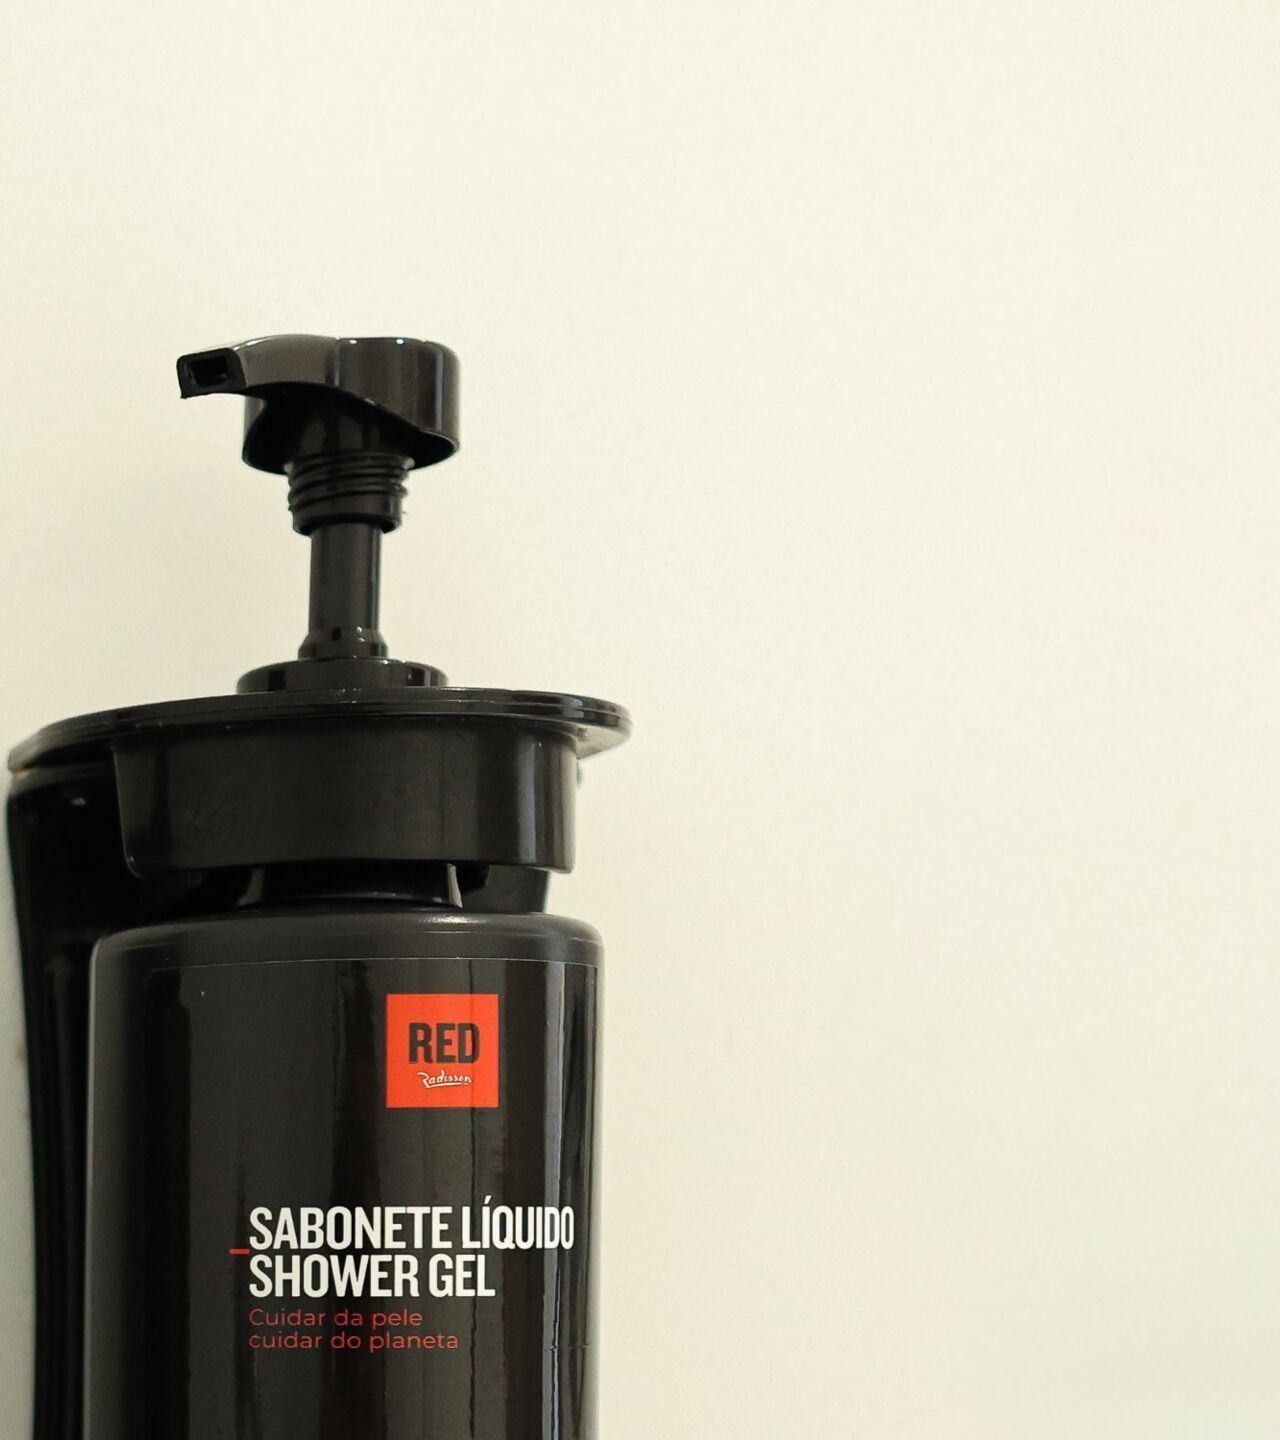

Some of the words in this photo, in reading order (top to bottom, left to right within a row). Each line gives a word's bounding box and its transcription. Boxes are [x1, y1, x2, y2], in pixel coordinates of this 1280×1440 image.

[409, 1022, 480, 1064] RED
[249, 1206, 453, 1250] SABONETE
[461, 1195, 575, 1250] LÍQUIDO
[249, 1254, 420, 1298] SHOWER
[428, 1254, 496, 1298] GEL
[249, 1308, 325, 1326] Cuidar
[334, 1308, 364, 1326] da
[372, 1308, 423, 1328] pele
[249, 1332, 322, 1349] cuidar
[330, 1332, 361, 1349] do
[369, 1331, 459, 1351] planeta
